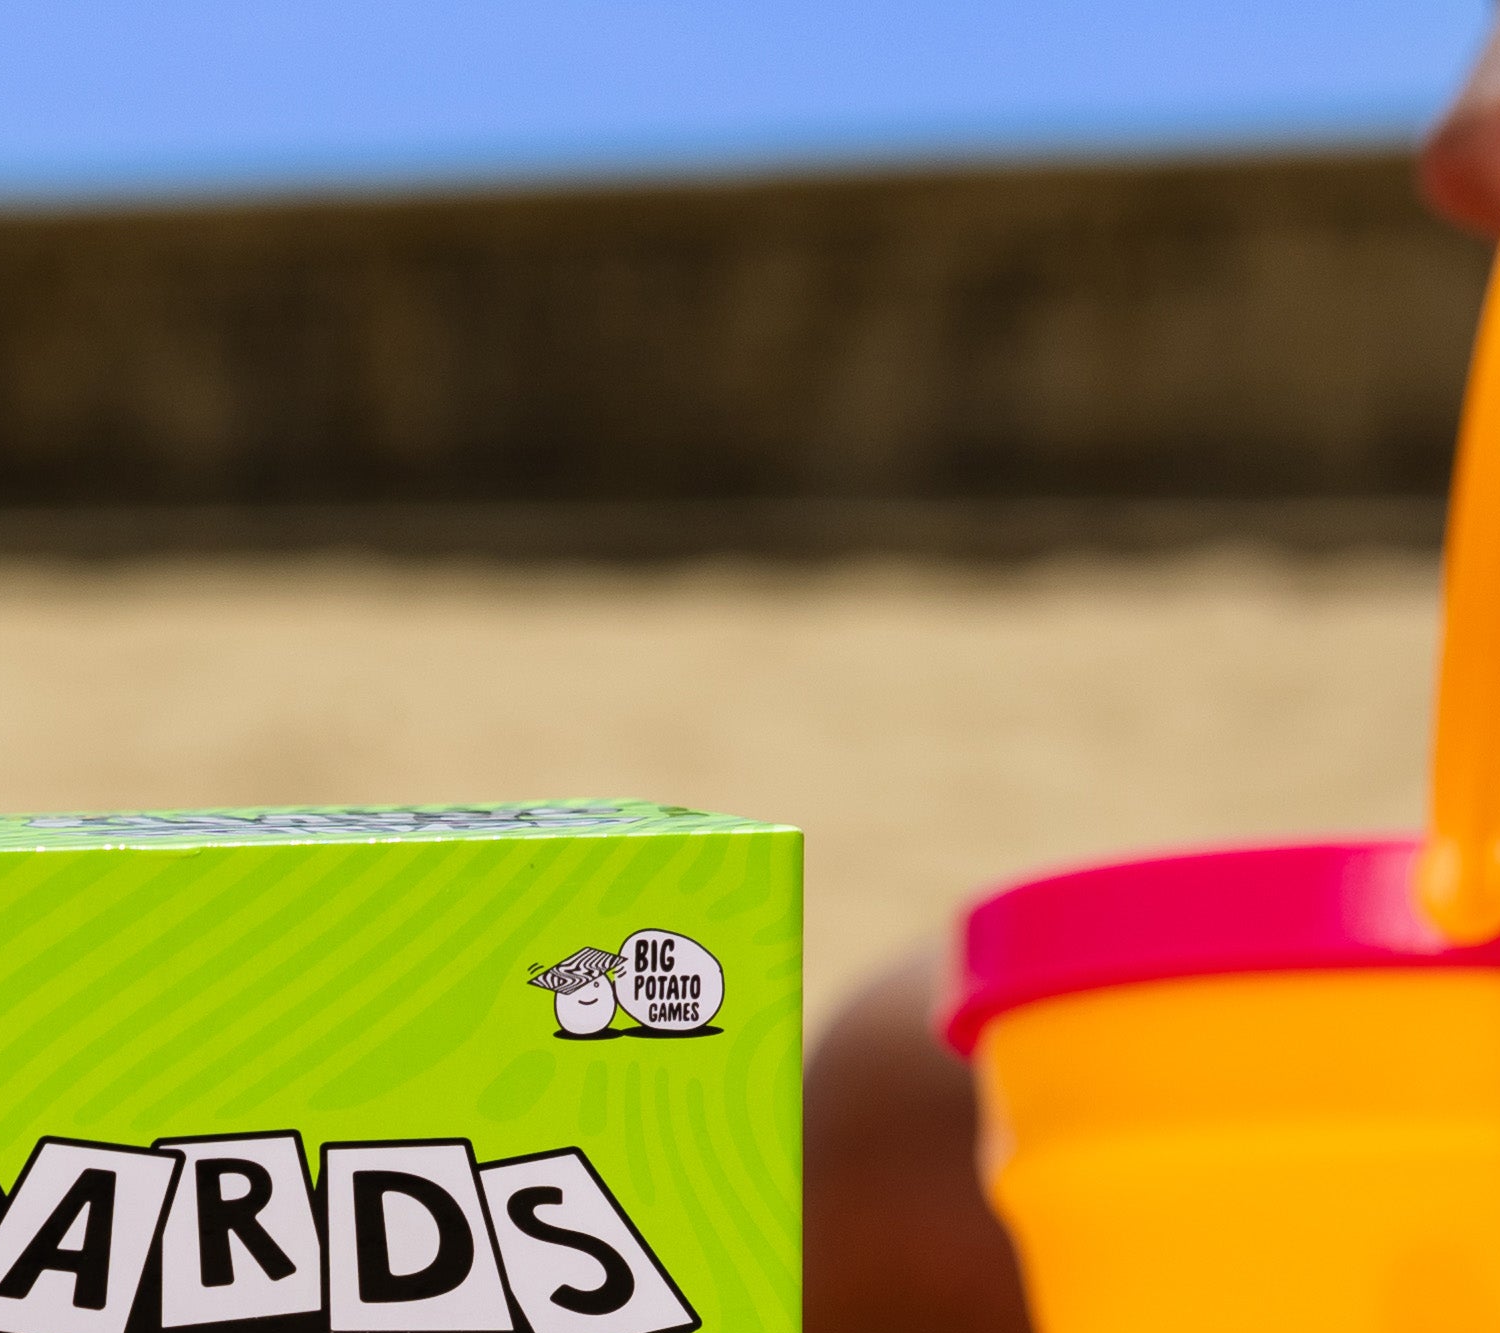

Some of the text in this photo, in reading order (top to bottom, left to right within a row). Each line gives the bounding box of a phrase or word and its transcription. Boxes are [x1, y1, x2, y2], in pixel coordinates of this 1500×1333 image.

[634, 938, 675, 973] BIG
[634, 974, 701, 1001] POTATO
[648, 1002, 700, 1023] GAMES
